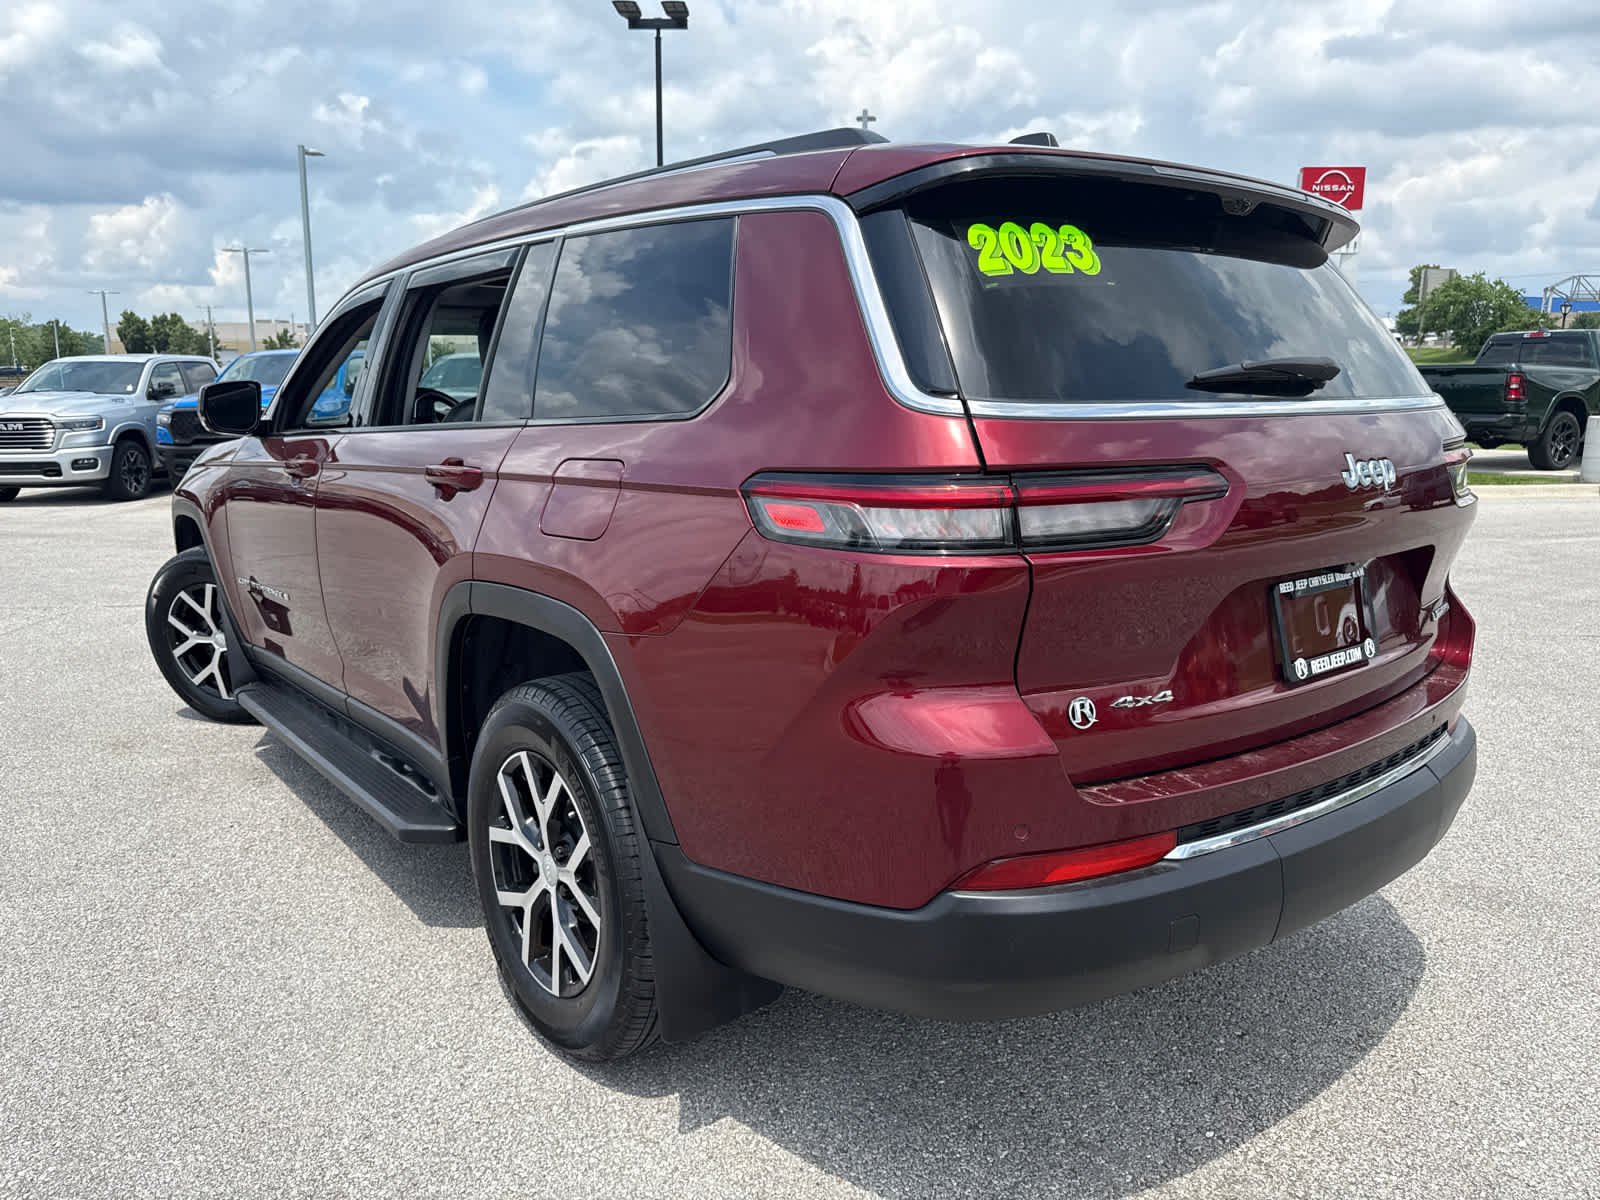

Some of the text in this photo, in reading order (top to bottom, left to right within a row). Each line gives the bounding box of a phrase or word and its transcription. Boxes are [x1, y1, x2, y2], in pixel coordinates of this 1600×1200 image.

[967, 221, 1101, 277] 2023
[1341, 453, 1396, 491] Jeep
[1279, 581, 1294, 593] REED
[1295, 579, 1307, 590] JEEP
